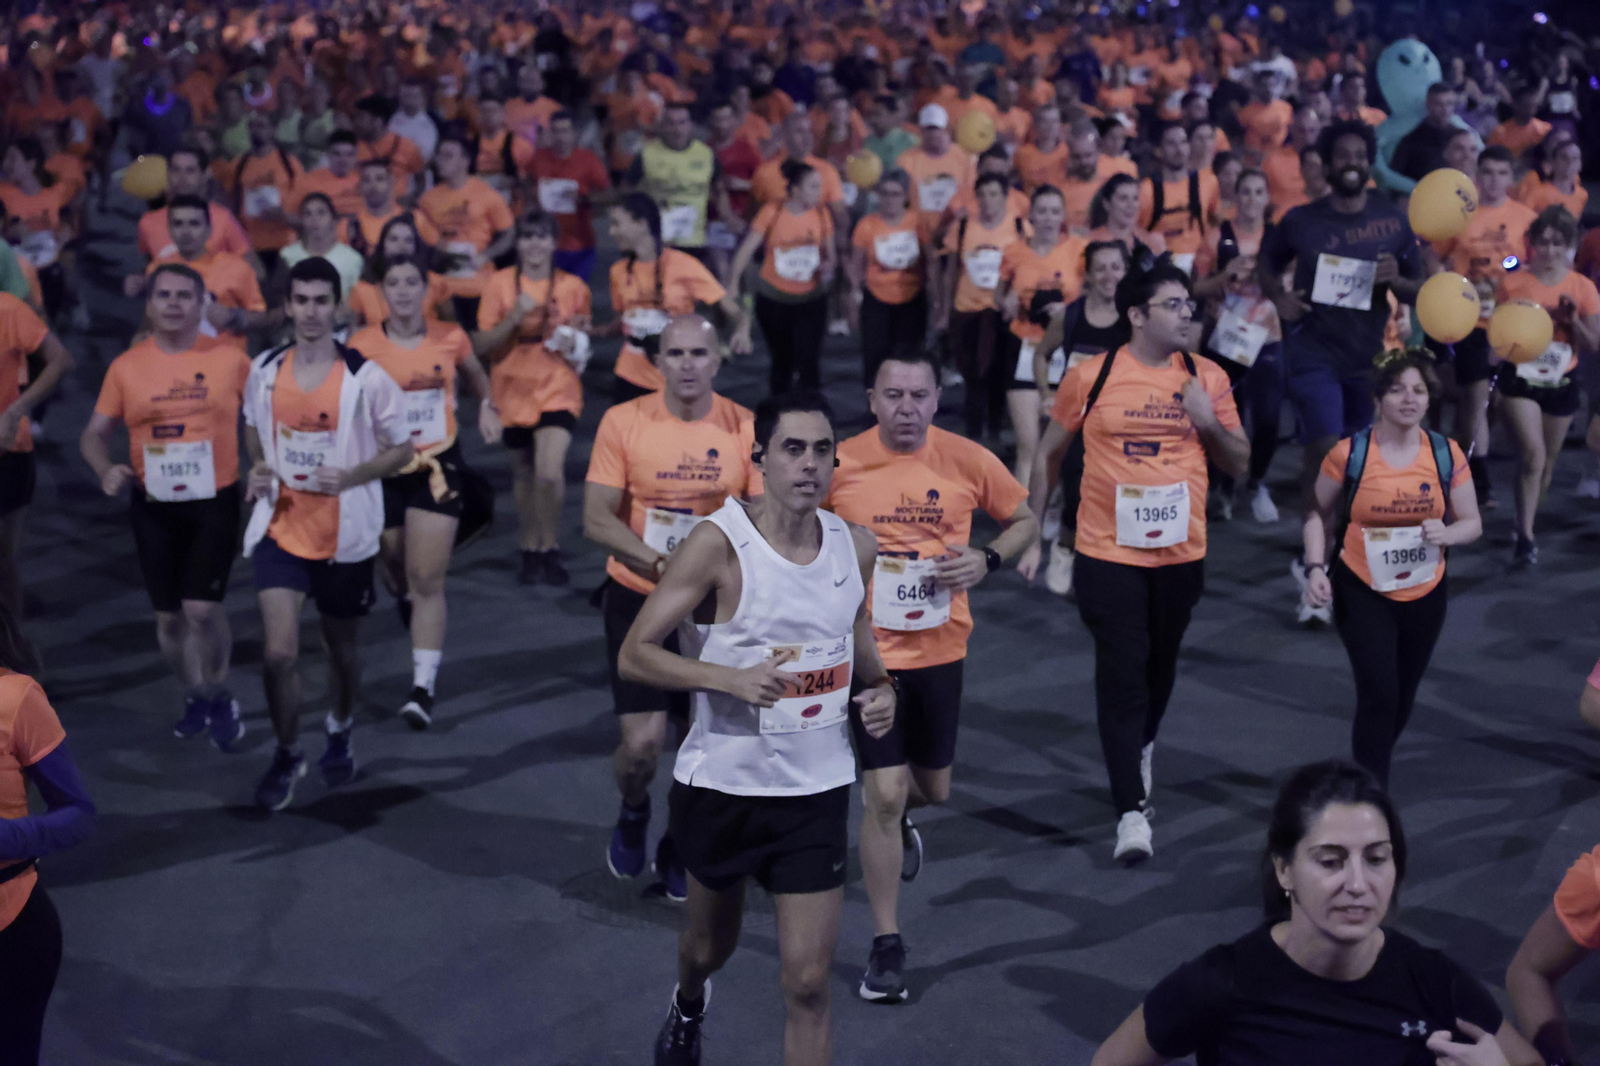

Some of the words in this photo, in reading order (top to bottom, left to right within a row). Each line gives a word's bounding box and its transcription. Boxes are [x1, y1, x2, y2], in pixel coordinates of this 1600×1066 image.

[872, 515, 916, 524] SEVILLA
[918, 515, 943, 525] KH7
[1133, 505, 1178, 522] 13965
[1382, 547, 1427, 565] 13966
[897, 583, 937, 601] 6464
